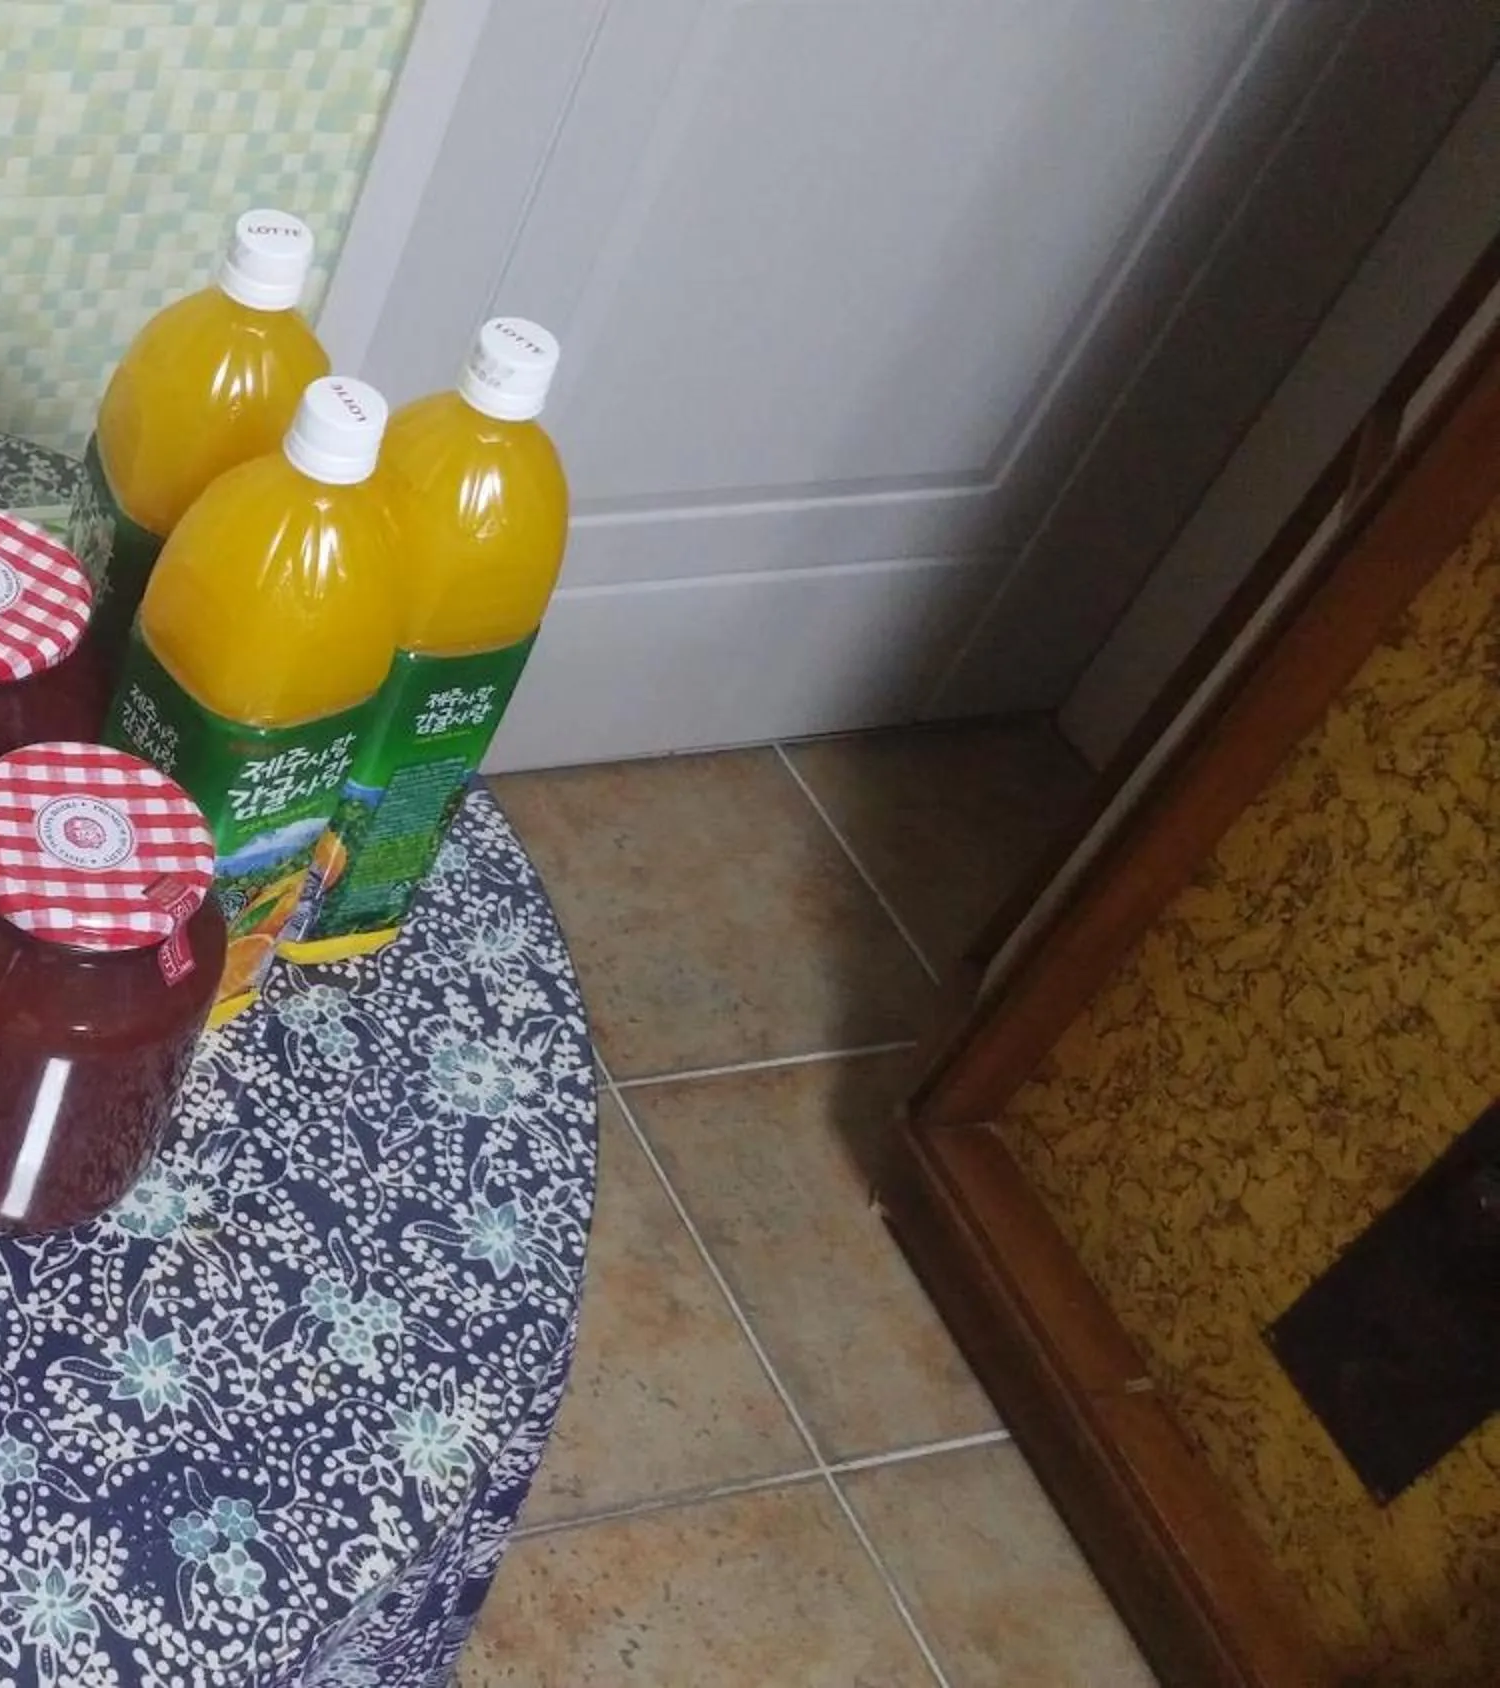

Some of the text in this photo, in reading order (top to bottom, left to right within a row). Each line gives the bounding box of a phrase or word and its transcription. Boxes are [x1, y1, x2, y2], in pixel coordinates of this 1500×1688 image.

[247, 223, 301, 237] LOTTE
[495, 322, 545, 354] LOTTE
[330, 383, 367, 423] LOTTE
[424, 684, 497, 710] 제주사랑
[414, 701, 493, 736] 감귤사랑
[240, 731, 357, 783] 제주사랑
[227, 754, 354, 821] 감귤사랑
